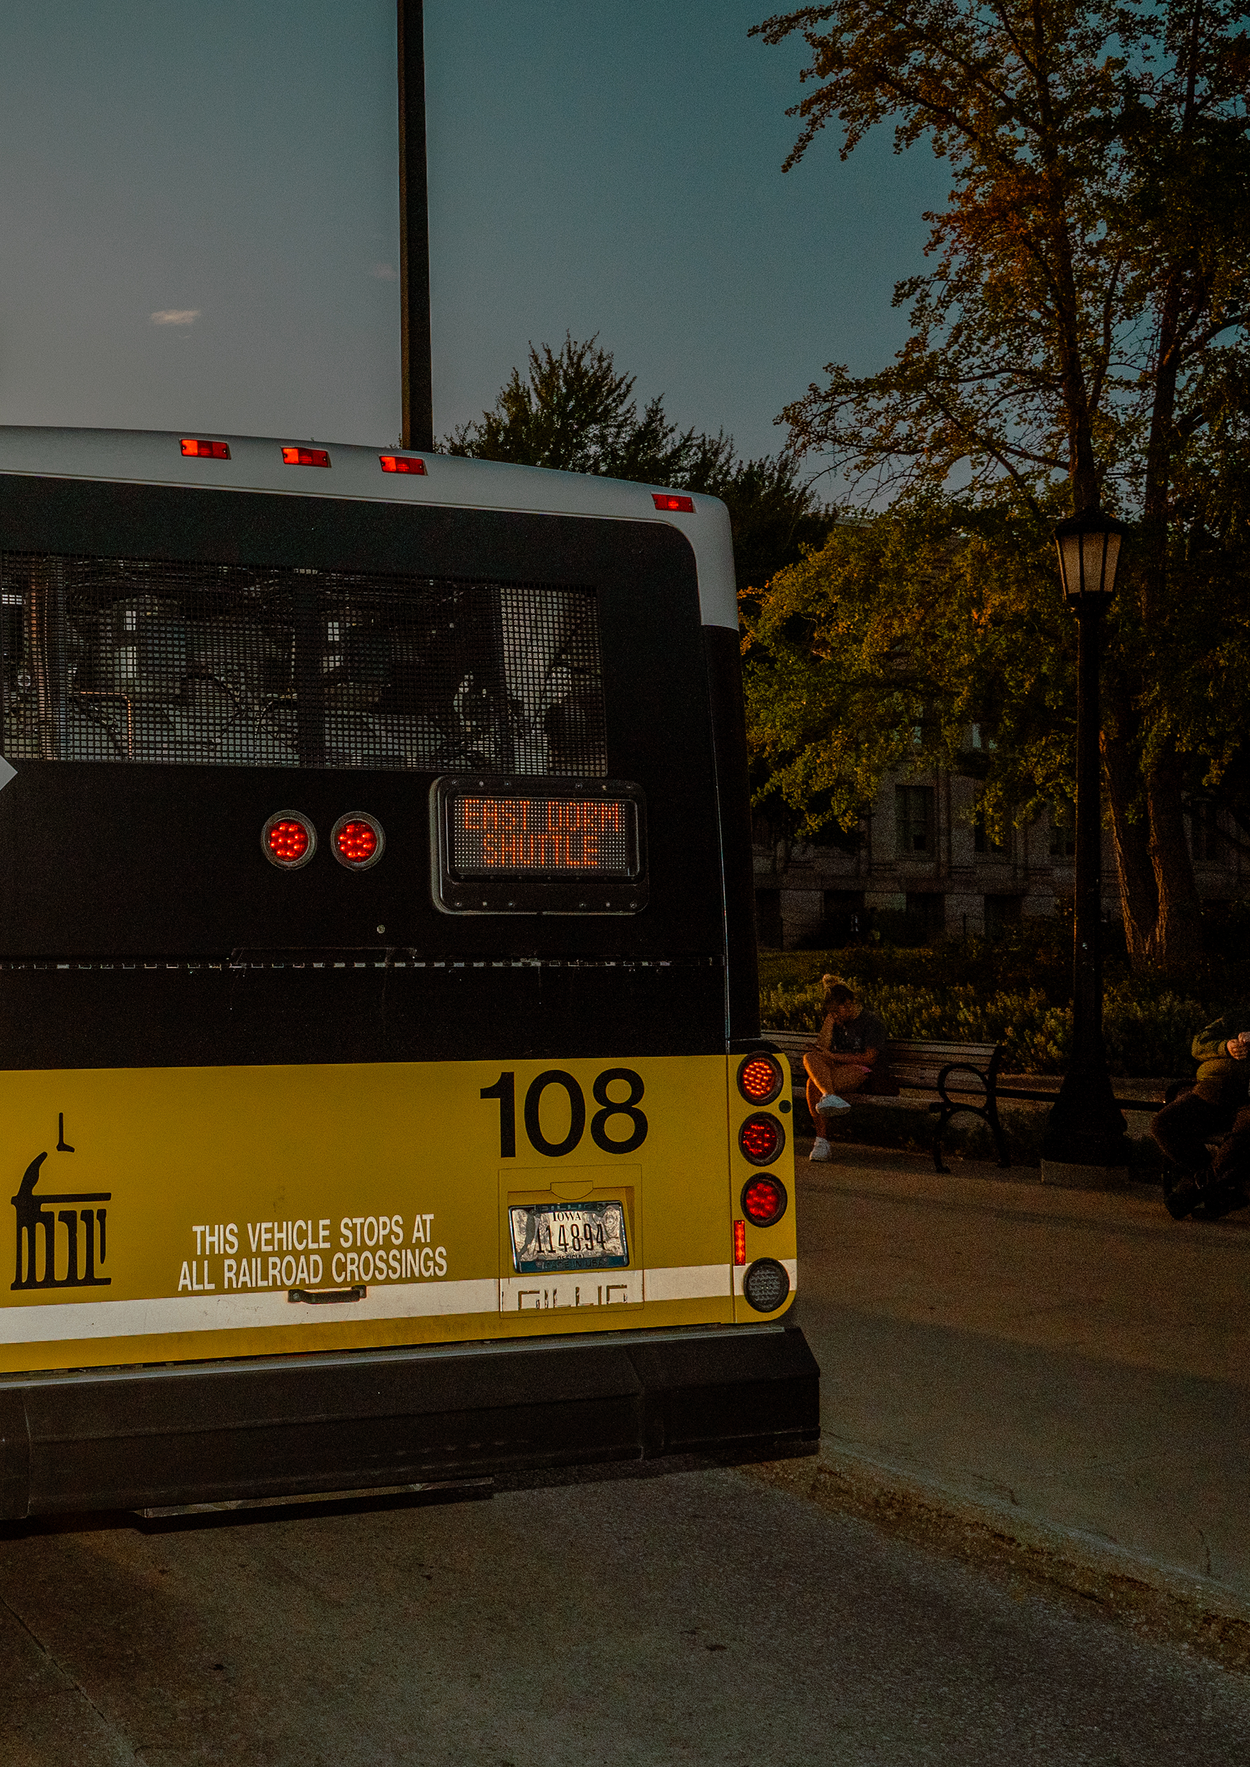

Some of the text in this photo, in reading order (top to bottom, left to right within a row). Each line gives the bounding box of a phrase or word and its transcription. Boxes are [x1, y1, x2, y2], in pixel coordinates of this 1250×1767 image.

[465, 799, 618, 832] EAST DORM
[483, 834, 598, 865] SHUTTLE
[480, 1067, 649, 1158] 108
[552, 1211, 582, 1221] IOWA
[192, 1213, 434, 1255] THIS VEHICLE STOPS AT
[536, 1223, 606, 1253] 114894
[178, 1246, 448, 1292] ALL RAILROAD CROSSINGS
